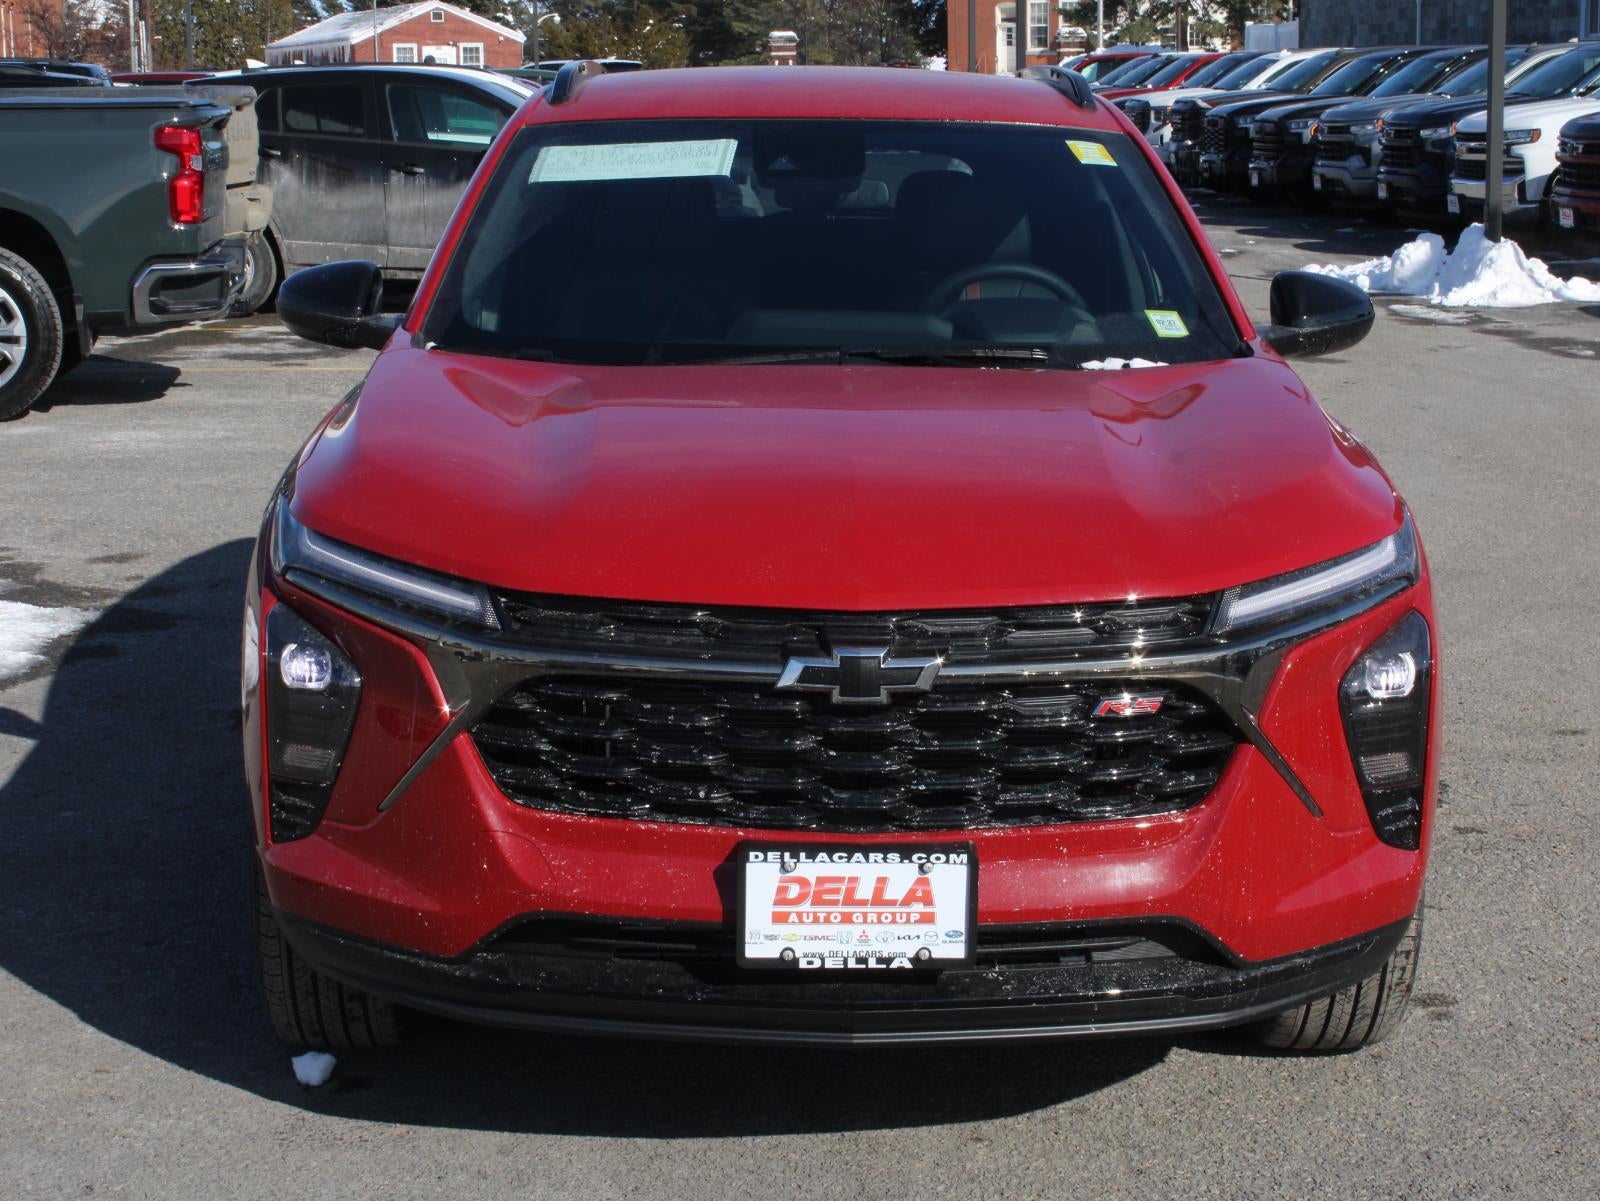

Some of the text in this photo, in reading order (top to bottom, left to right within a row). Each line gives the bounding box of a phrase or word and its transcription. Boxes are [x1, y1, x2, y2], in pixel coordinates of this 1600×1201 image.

[1092, 697, 1163, 725] RS
[749, 852, 968, 864] DELLACARS.COM
[773, 876, 935, 908] DELLA
[788, 913, 921, 923] AUTO GROUP
[802, 950, 907, 958] www.DELLACARS.com
[799, 957, 913, 969] DELLA
